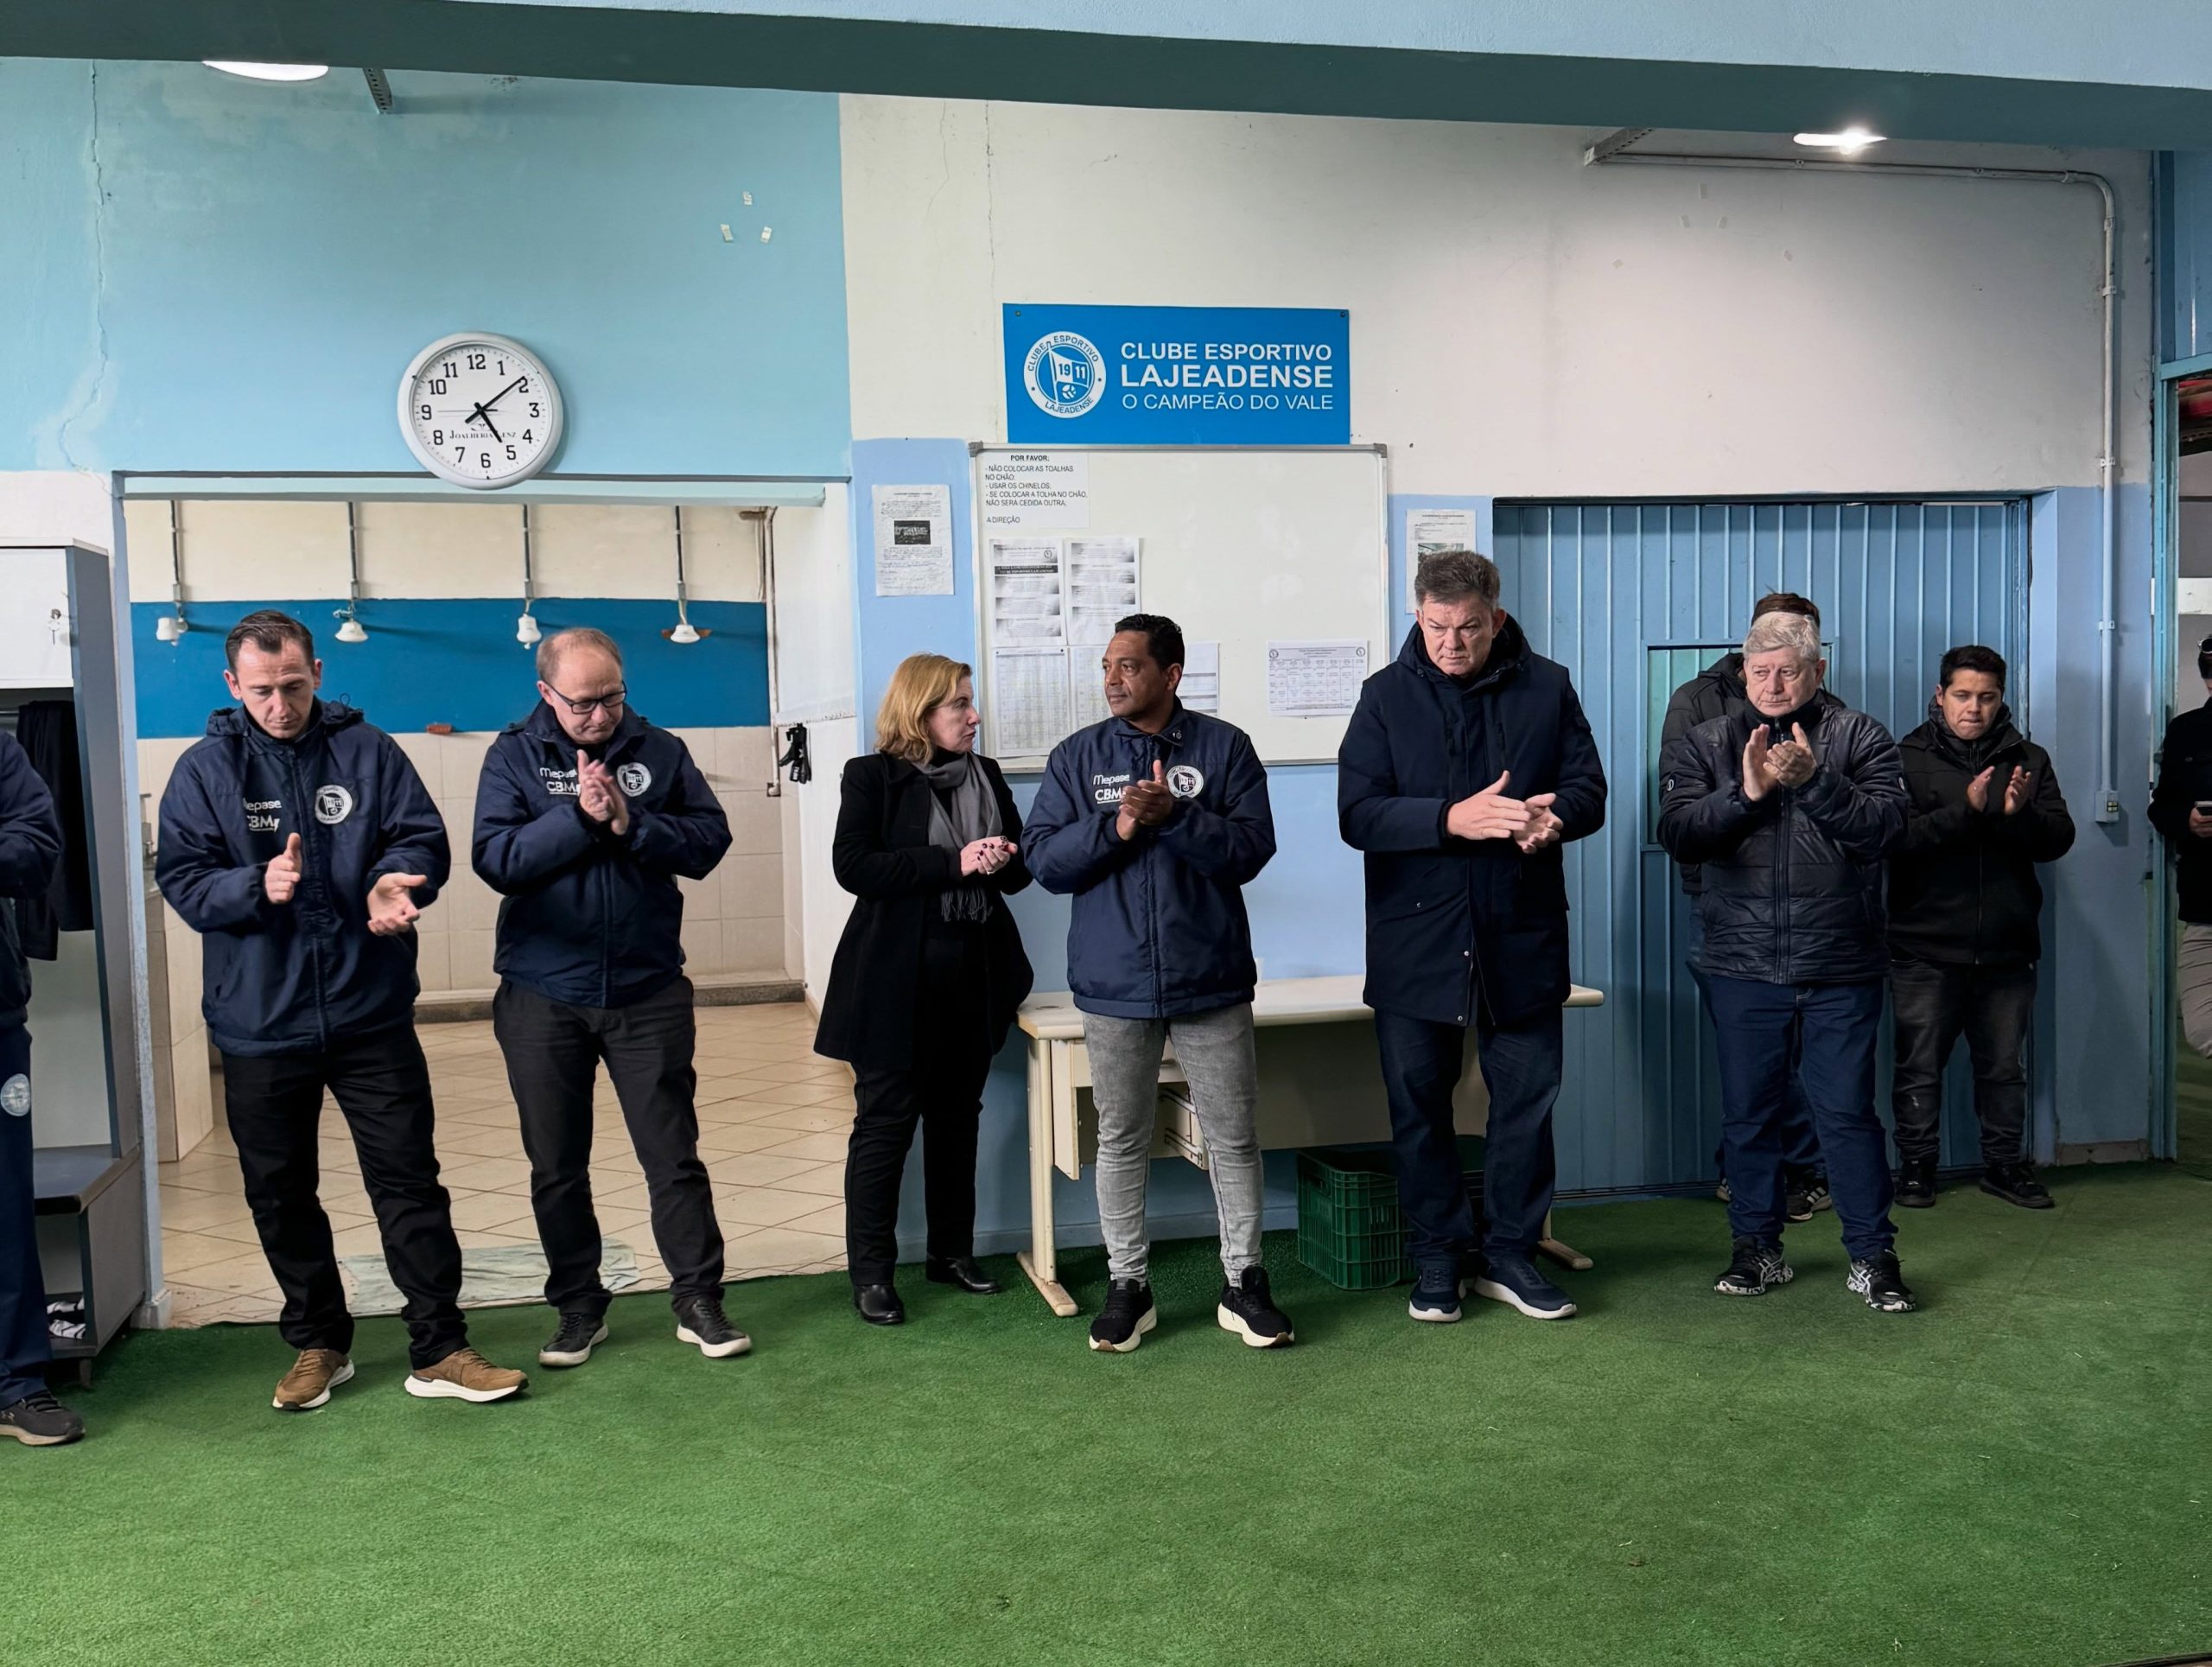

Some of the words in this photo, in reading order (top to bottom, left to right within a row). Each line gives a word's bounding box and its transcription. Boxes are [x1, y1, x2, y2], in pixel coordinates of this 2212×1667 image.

[1027, 342, 1046, 372] CLUBE
[1053, 334, 1099, 362] ESPORTIVO
[1121, 341, 1198, 360] CLUBE
[1205, 342, 1332, 361] ESPORTIVO
[467, 353, 486, 370] 12
[497, 360, 505, 376] 1
[442, 362, 459, 379] 11
[1121, 363, 1333, 388] LAJEADENSE
[428, 379, 448, 395] 10
[518, 376, 529, 393] 2
[1045, 397, 1094, 414] LAJEADENSE
[1122, 393, 1137, 410] O
[1143, 391, 1244, 410] CAMPEÃO
[1250, 394, 1280, 410] DO
[1285, 394, 1333, 410] VALE
[421, 404, 432, 421] 9
[529, 402, 540, 417] 3
[433, 429, 444, 445] 8
[522, 429, 533, 444] 4
[454, 446, 466, 463] 7
[480, 452, 492, 468] 6
[505, 444, 517, 461] 5
[988, 464, 1002, 473] NÃO
[992, 515, 1020, 524] DIREÇÃO
[1092, 773, 1131, 786] Mepase
